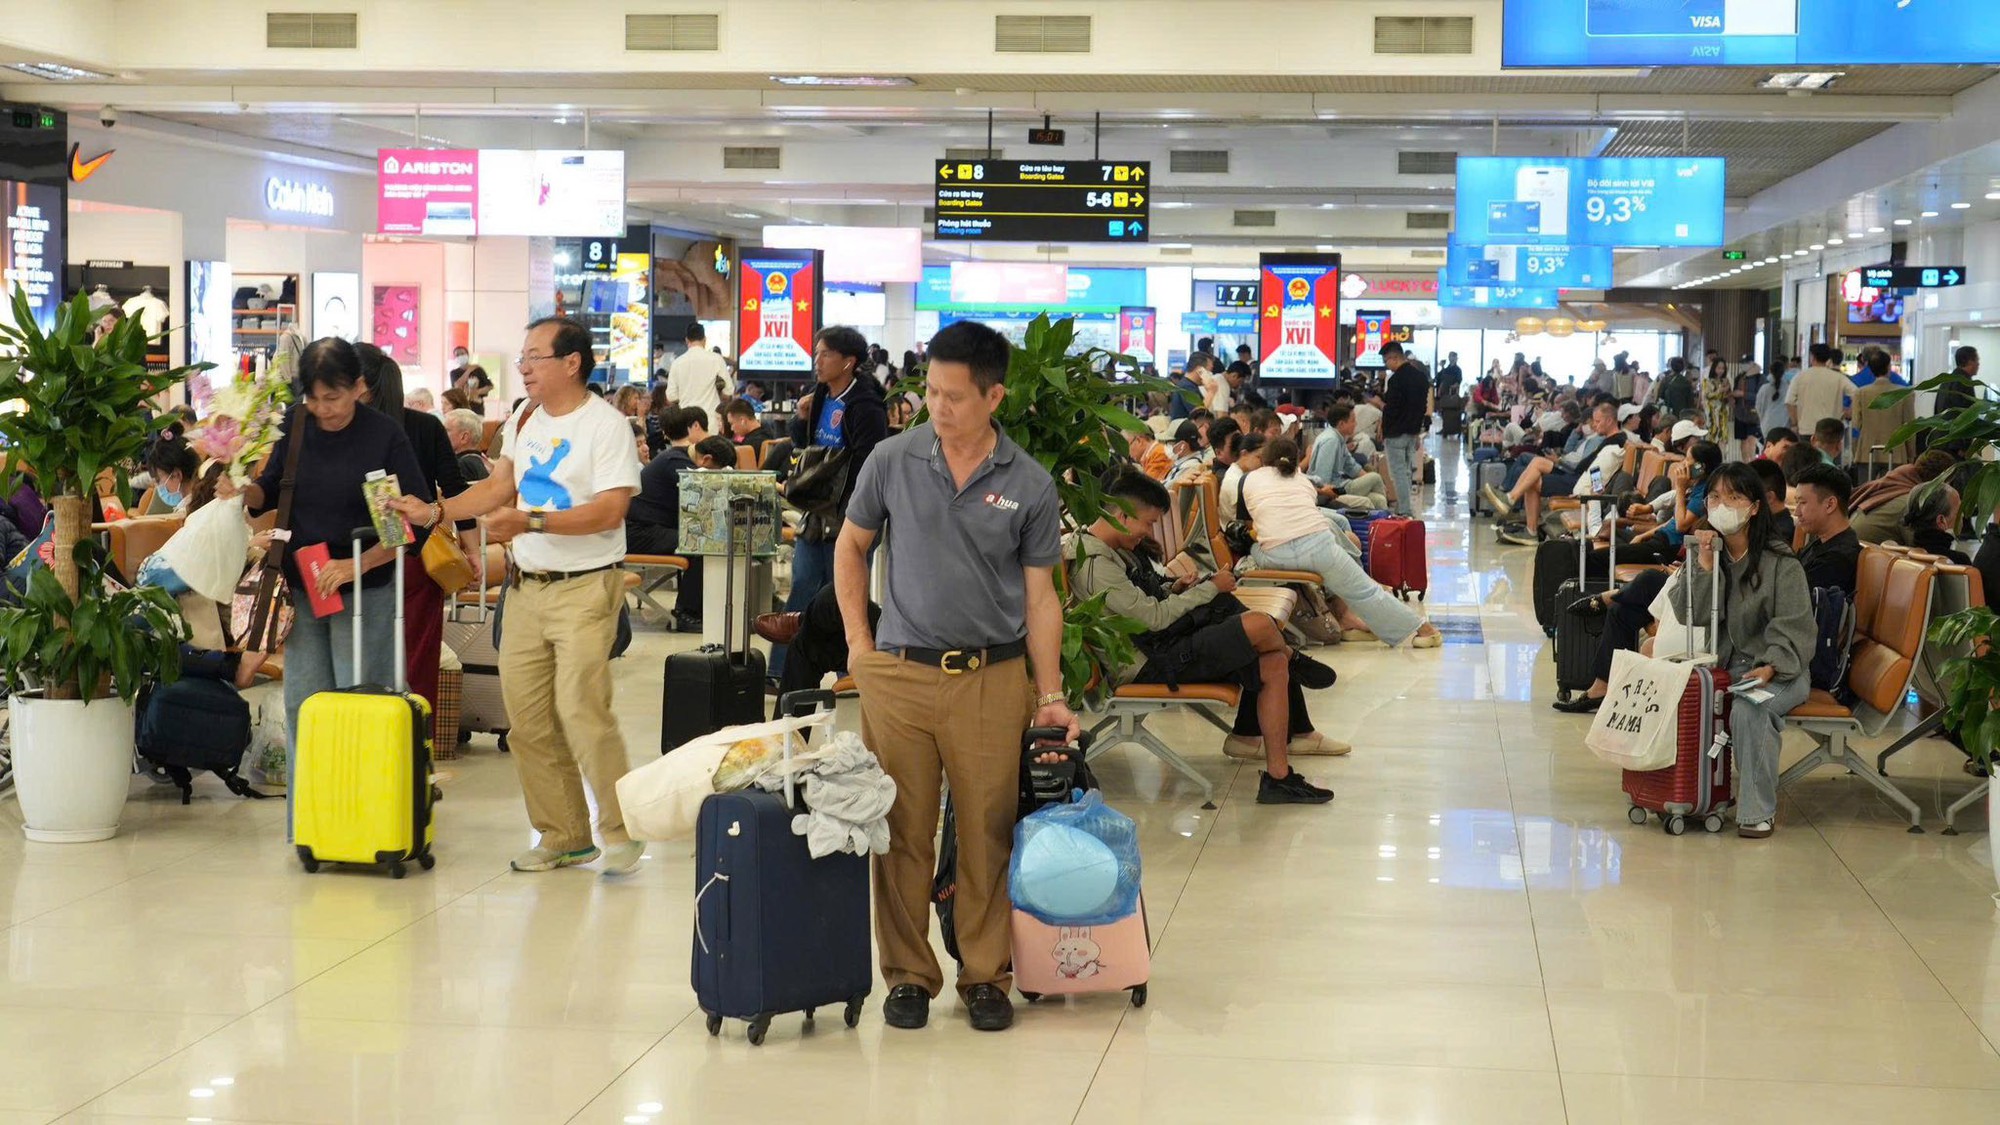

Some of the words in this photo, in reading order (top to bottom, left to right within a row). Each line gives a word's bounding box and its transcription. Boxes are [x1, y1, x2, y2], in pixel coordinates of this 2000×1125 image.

[1689, 16, 1721, 28] VISA
[401, 162, 474, 175] ARISTON
[973, 164, 984, 180] 8
[1101, 165, 1113, 181] 7
[1019, 173, 1046, 181] Boarding
[1587, 178, 1598, 188] Bộ
[1612, 178, 1630, 188] sinh
[1641, 179, 1655, 188] VIB
[266, 176, 306, 213] Calvin
[306, 182, 335, 217] Klein
[938, 199, 965, 208] Boarding
[965, 199, 983, 207] Gates
[1086, 191, 1112, 207] 5-6
[1586, 195, 1646, 226] 9,3%
[938, 227, 965, 236] Smoking
[589, 241, 603, 261] 8
[1527, 255, 1566, 276] 9,3%
[1230, 286, 1240, 301] 7
[1370, 279, 1419, 294] LUCKY
[764, 321, 788, 338] XVI
[1286, 328, 1311, 345] XVI
[1606, 711, 1643, 733] MAMA
